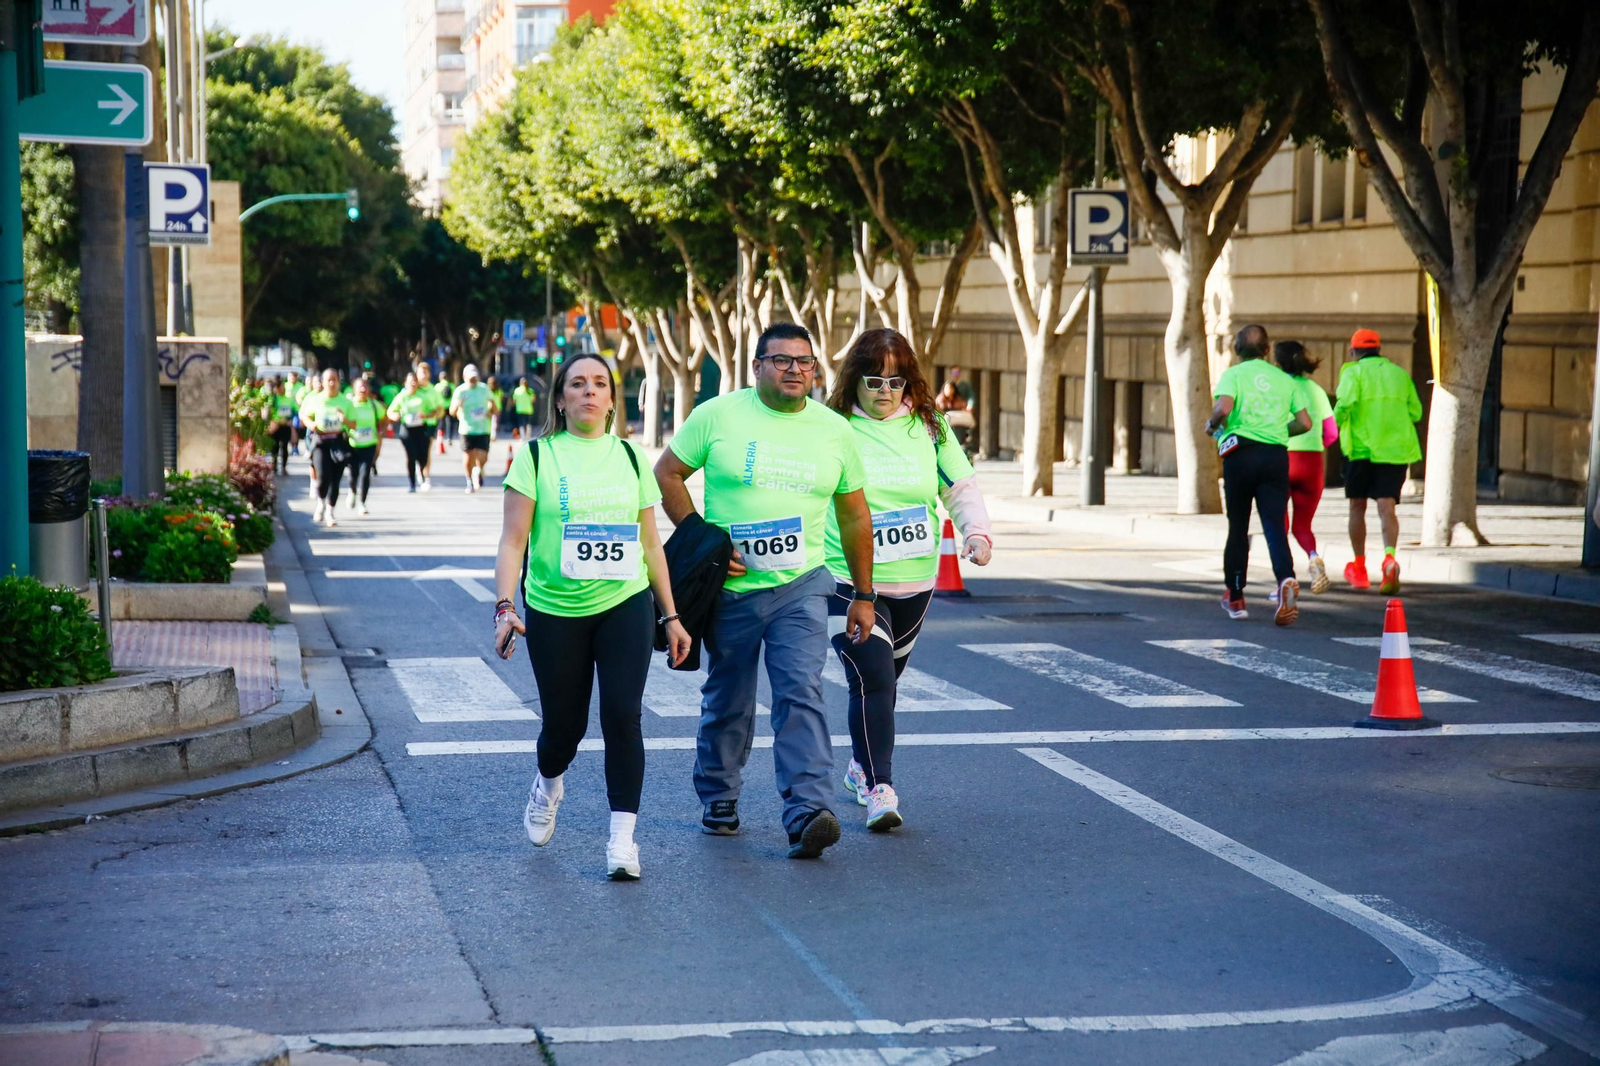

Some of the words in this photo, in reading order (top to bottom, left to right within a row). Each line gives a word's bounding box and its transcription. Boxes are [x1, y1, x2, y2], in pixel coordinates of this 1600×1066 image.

[149, 167, 203, 231] P
[166, 220, 187, 232] 24h
[1075, 193, 1125, 253] P
[1090, 243, 1109, 253] 24h
[742, 440, 757, 486] ALMERÍA
[757, 453, 772, 464] En
[775, 457, 817, 471] marcha
[757, 465, 800, 478] contra
[804, 471, 816, 482] el
[755, 476, 816, 494] cáncer
[558, 476, 570, 522] ALMERÍA
[572, 494, 617, 509] contra
[573, 508, 631, 523] cáncer
[873, 523, 928, 547] 1068
[577, 542, 624, 561] 935
[739, 534, 798, 556] 1069
